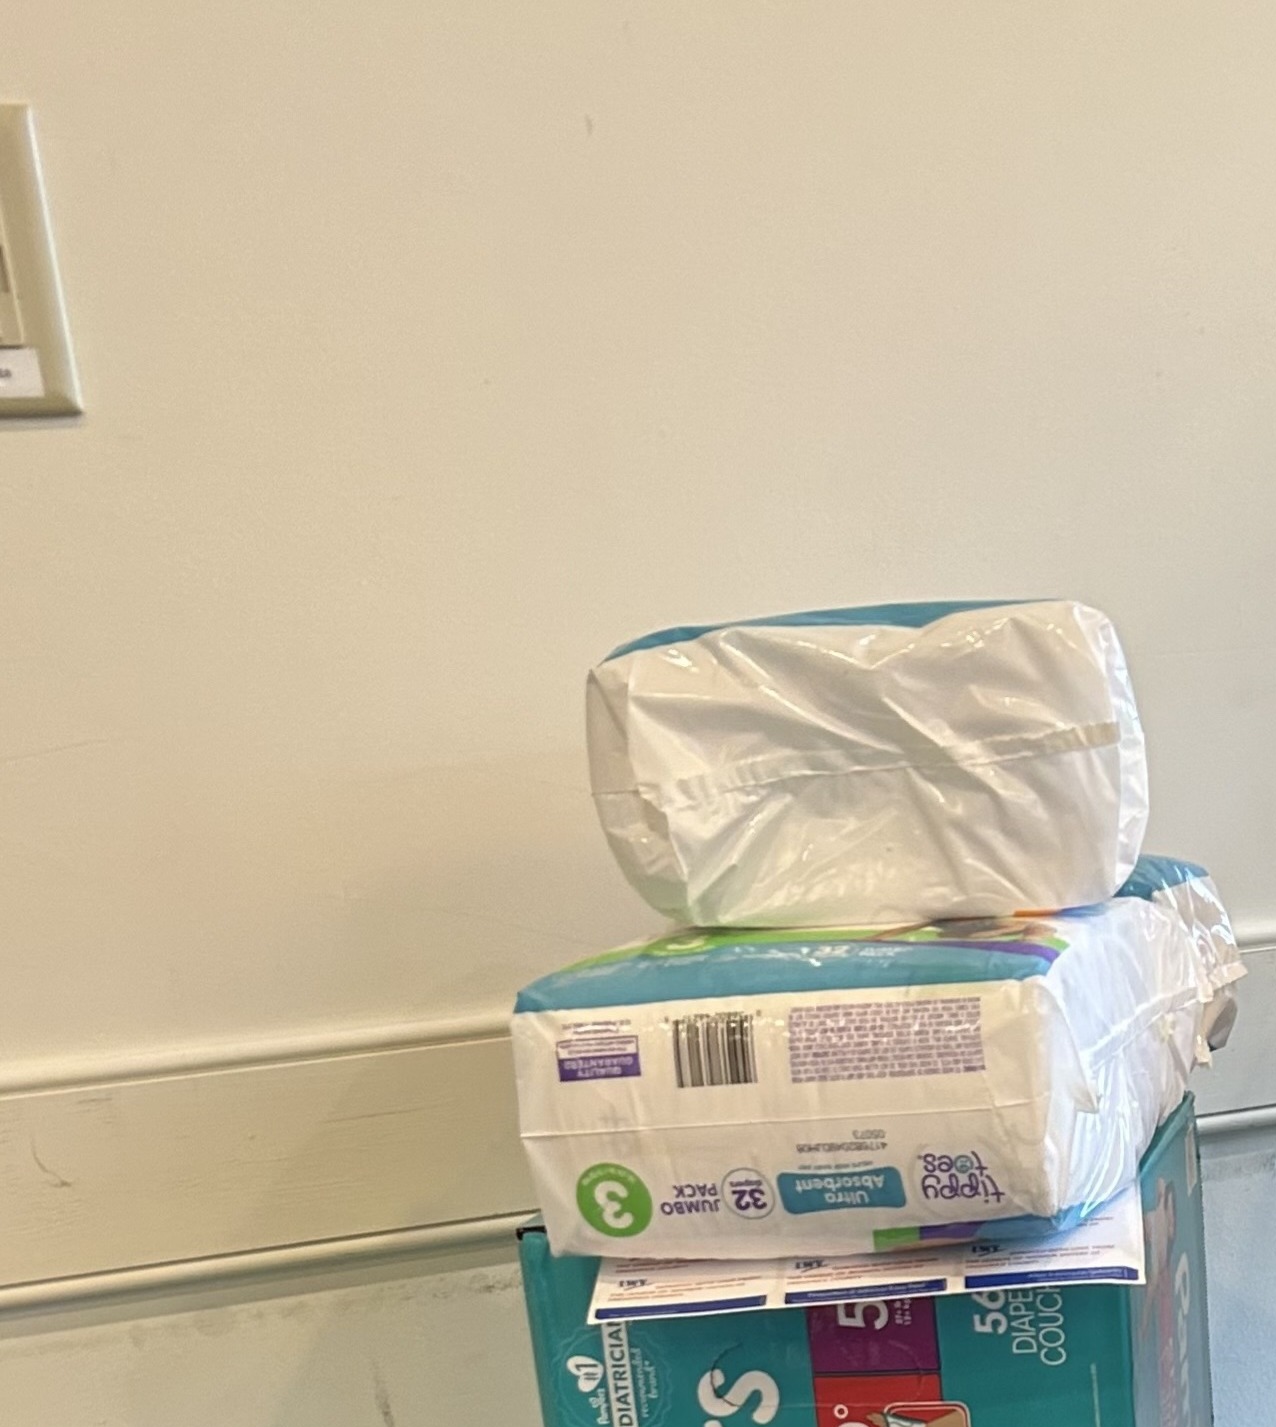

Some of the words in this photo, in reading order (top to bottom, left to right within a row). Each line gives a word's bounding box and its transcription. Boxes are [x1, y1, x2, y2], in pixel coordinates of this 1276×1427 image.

[923, 1151, 988, 1177] toes
[673, 1183, 718, 1198] PACK
[795, 1174, 885, 1193] Absorbent
[921, 1174, 1005, 1203] tippy
[595, 1181, 634, 1228] 3
[660, 1199, 721, 1216] JUMBO
[731, 1189, 767, 1211] 32
[824, 1190, 869, 1204] Ultra
[836, 1300, 889, 1330] 5
[971, 1290, 1008, 1334] 56
